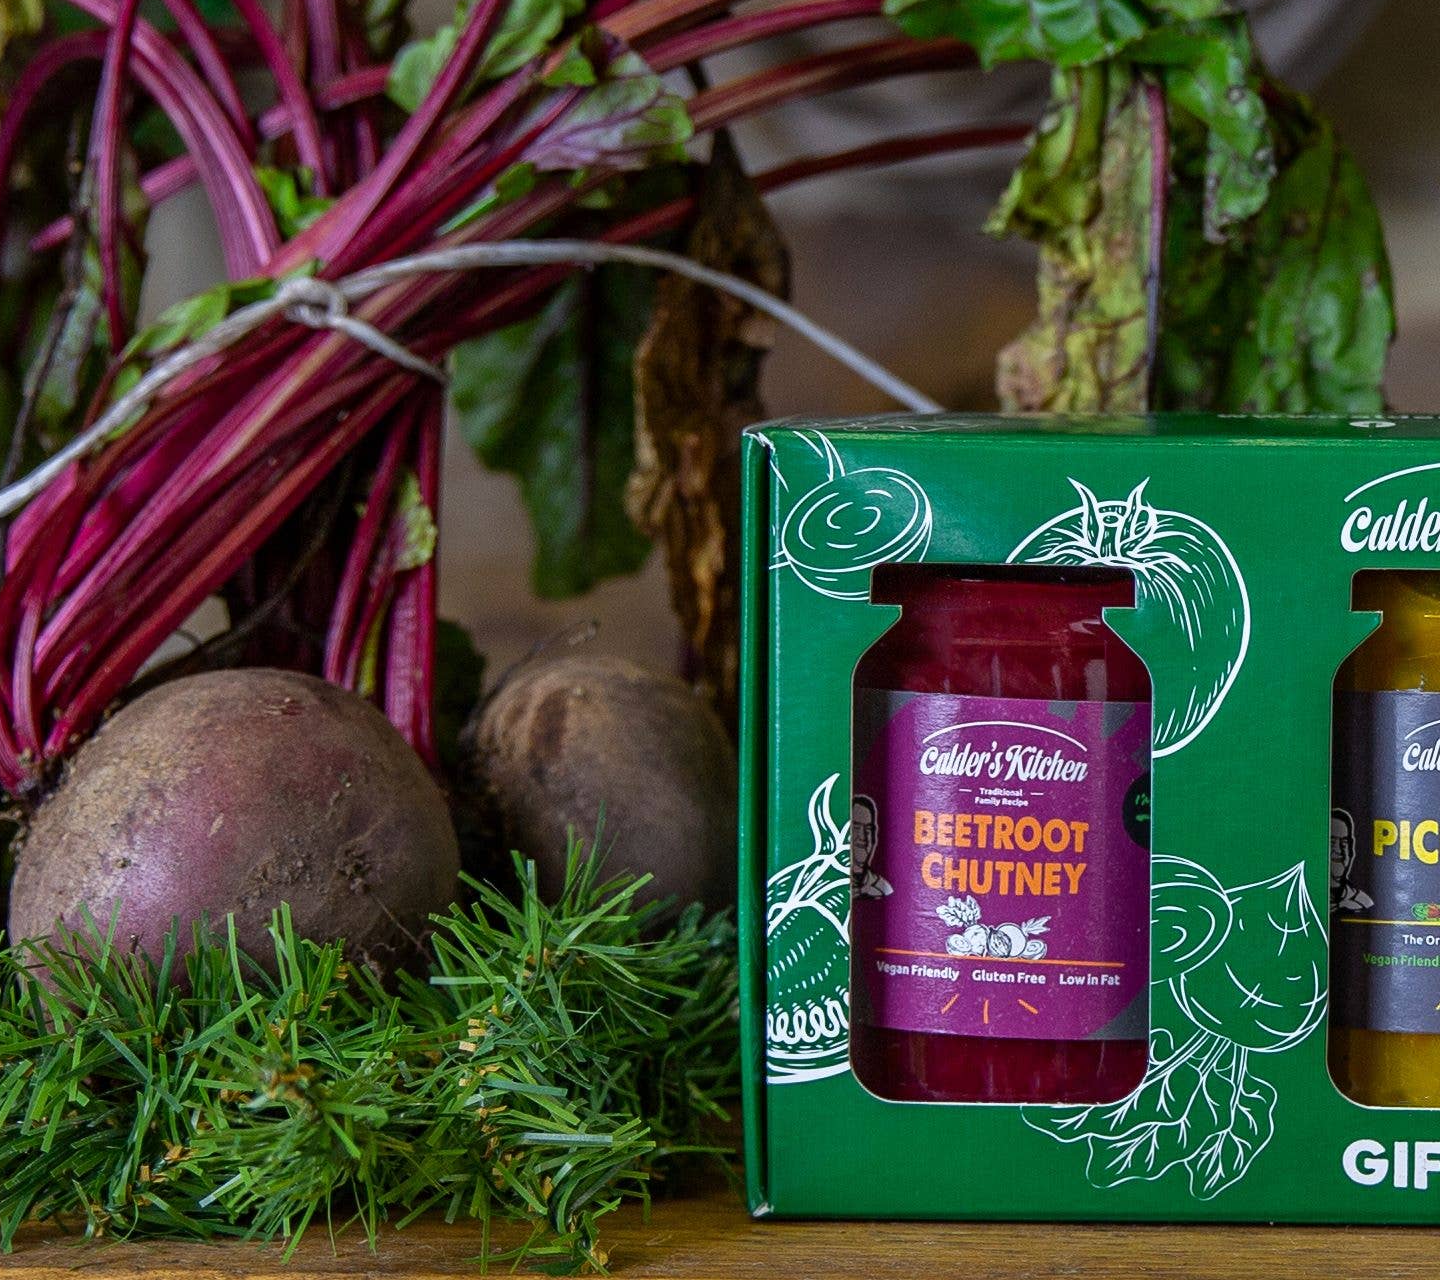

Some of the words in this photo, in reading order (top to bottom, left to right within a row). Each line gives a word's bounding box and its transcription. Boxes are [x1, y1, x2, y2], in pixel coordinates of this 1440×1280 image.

[919, 741, 1003, 778] Calder's
[1004, 745, 1088, 782] Kitchen
[979, 787, 1023, 797] Traditional
[974, 797, 1001, 807] Family
[1002, 798, 1029, 808] Recipe
[914, 810, 1089, 853] BEETROOT
[921, 852, 1087, 896] CHUTNEY
[1402, 934, 1423, 946] The
[1363, 952, 1399, 967] Vegan
[877, 960, 910, 976] Vegan
[911, 964, 960, 982] Friendly
[972, 969, 1014, 983] Gluten
[1017, 971, 1047, 984] Free
[1059, 973, 1085, 985] Low
[1087, 973, 1098, 985] in
[1100, 973, 1120, 986] Fat
